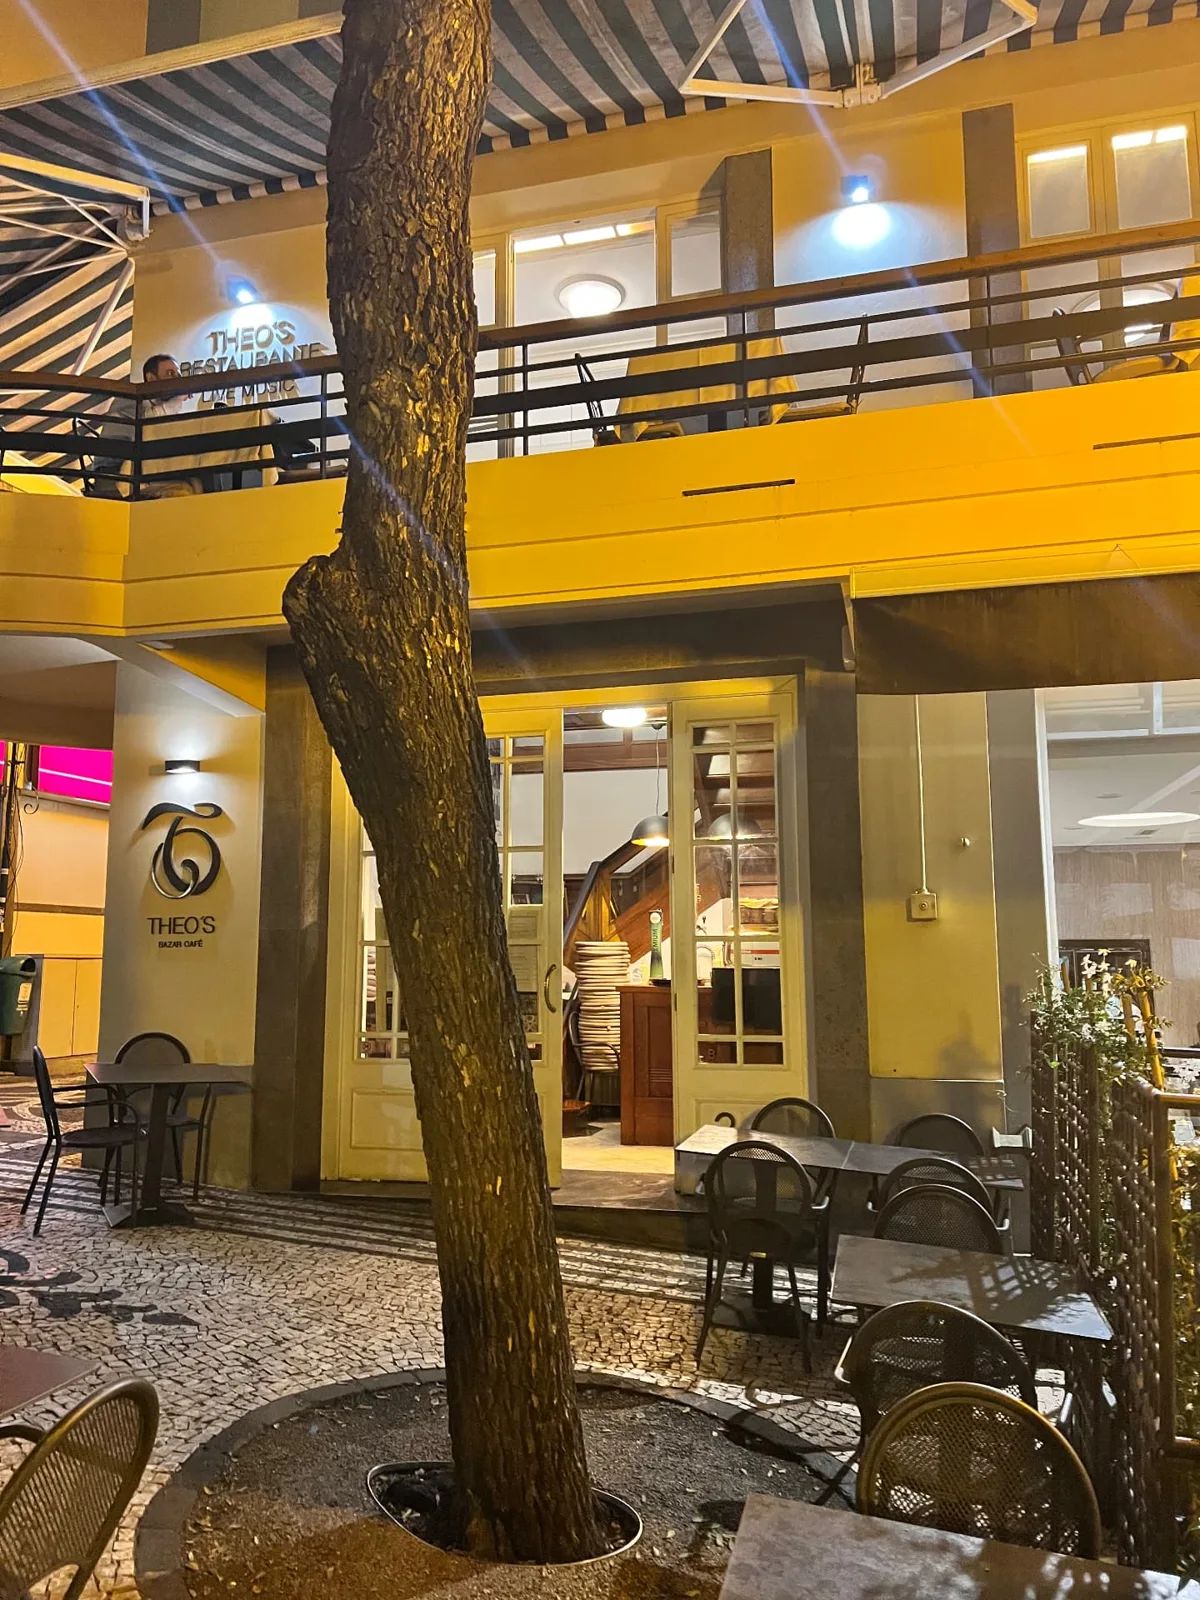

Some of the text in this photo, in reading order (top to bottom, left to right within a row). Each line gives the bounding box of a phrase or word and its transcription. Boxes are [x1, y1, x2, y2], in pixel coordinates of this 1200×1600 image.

[208, 321, 295, 354] THEO'S
[202, 379, 295, 402] LIVE MUSIC
[146, 916, 216, 934] THEO'S
[158, 939, 203, 948] BAZAR CAFÉ
